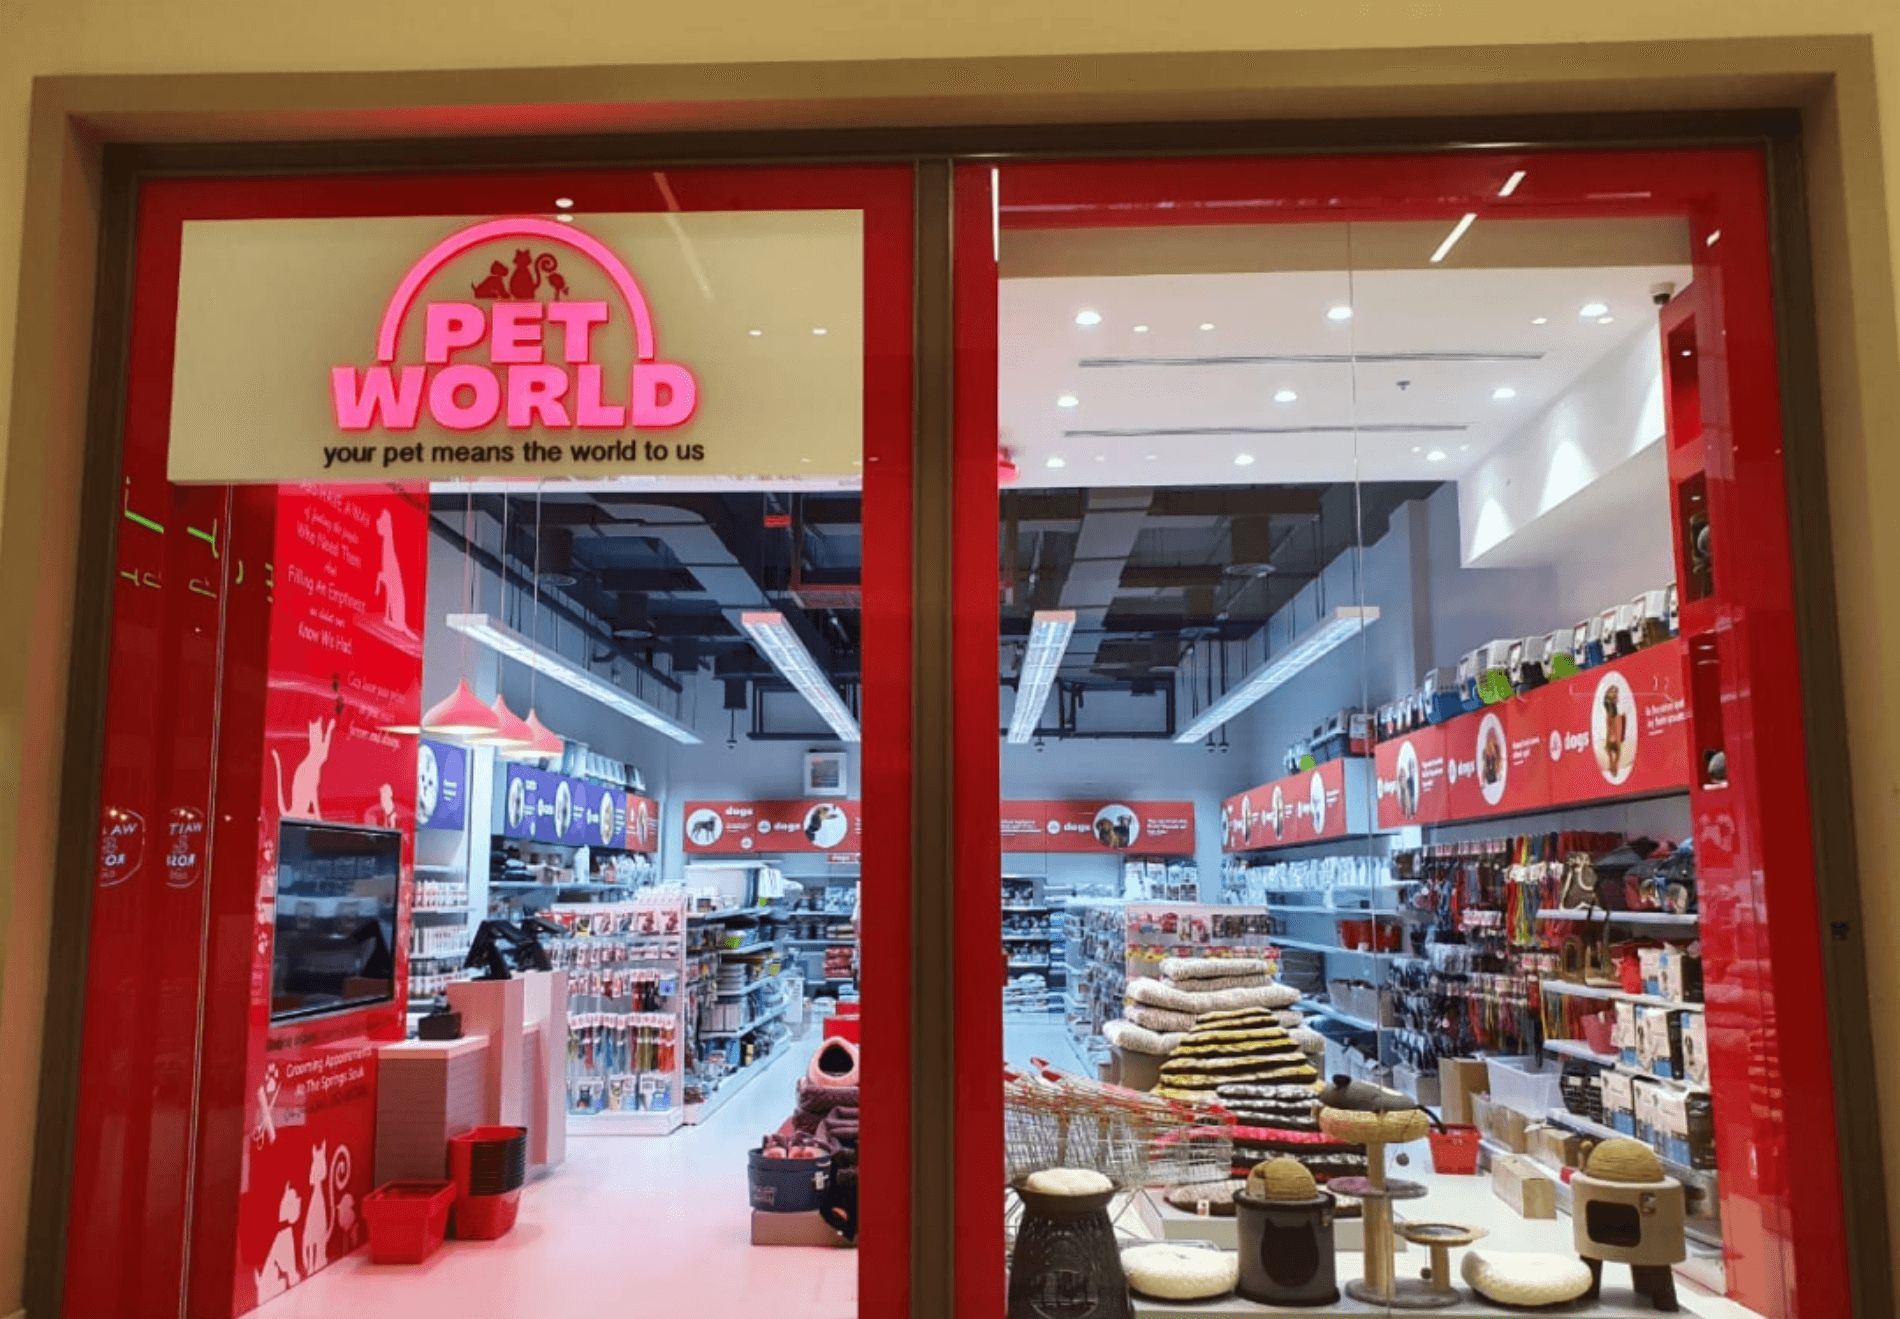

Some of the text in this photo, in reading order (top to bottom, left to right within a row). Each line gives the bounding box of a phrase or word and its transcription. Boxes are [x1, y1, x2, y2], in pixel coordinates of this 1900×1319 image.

[425, 301, 608, 363] PET
[332, 364, 698, 429] WORLD
[323, 440, 704, 468] your pet means the world to us
[288, 564, 314, 596] Filling
[1564, 731, 1590, 752] dogs
[725, 806, 753, 817] dogs
[773, 822, 800, 832] dogs
[1063, 822, 1091, 833] dogs
[286, 1058, 324, 1078] Grooming
[306, 1079, 320, 1093] The
